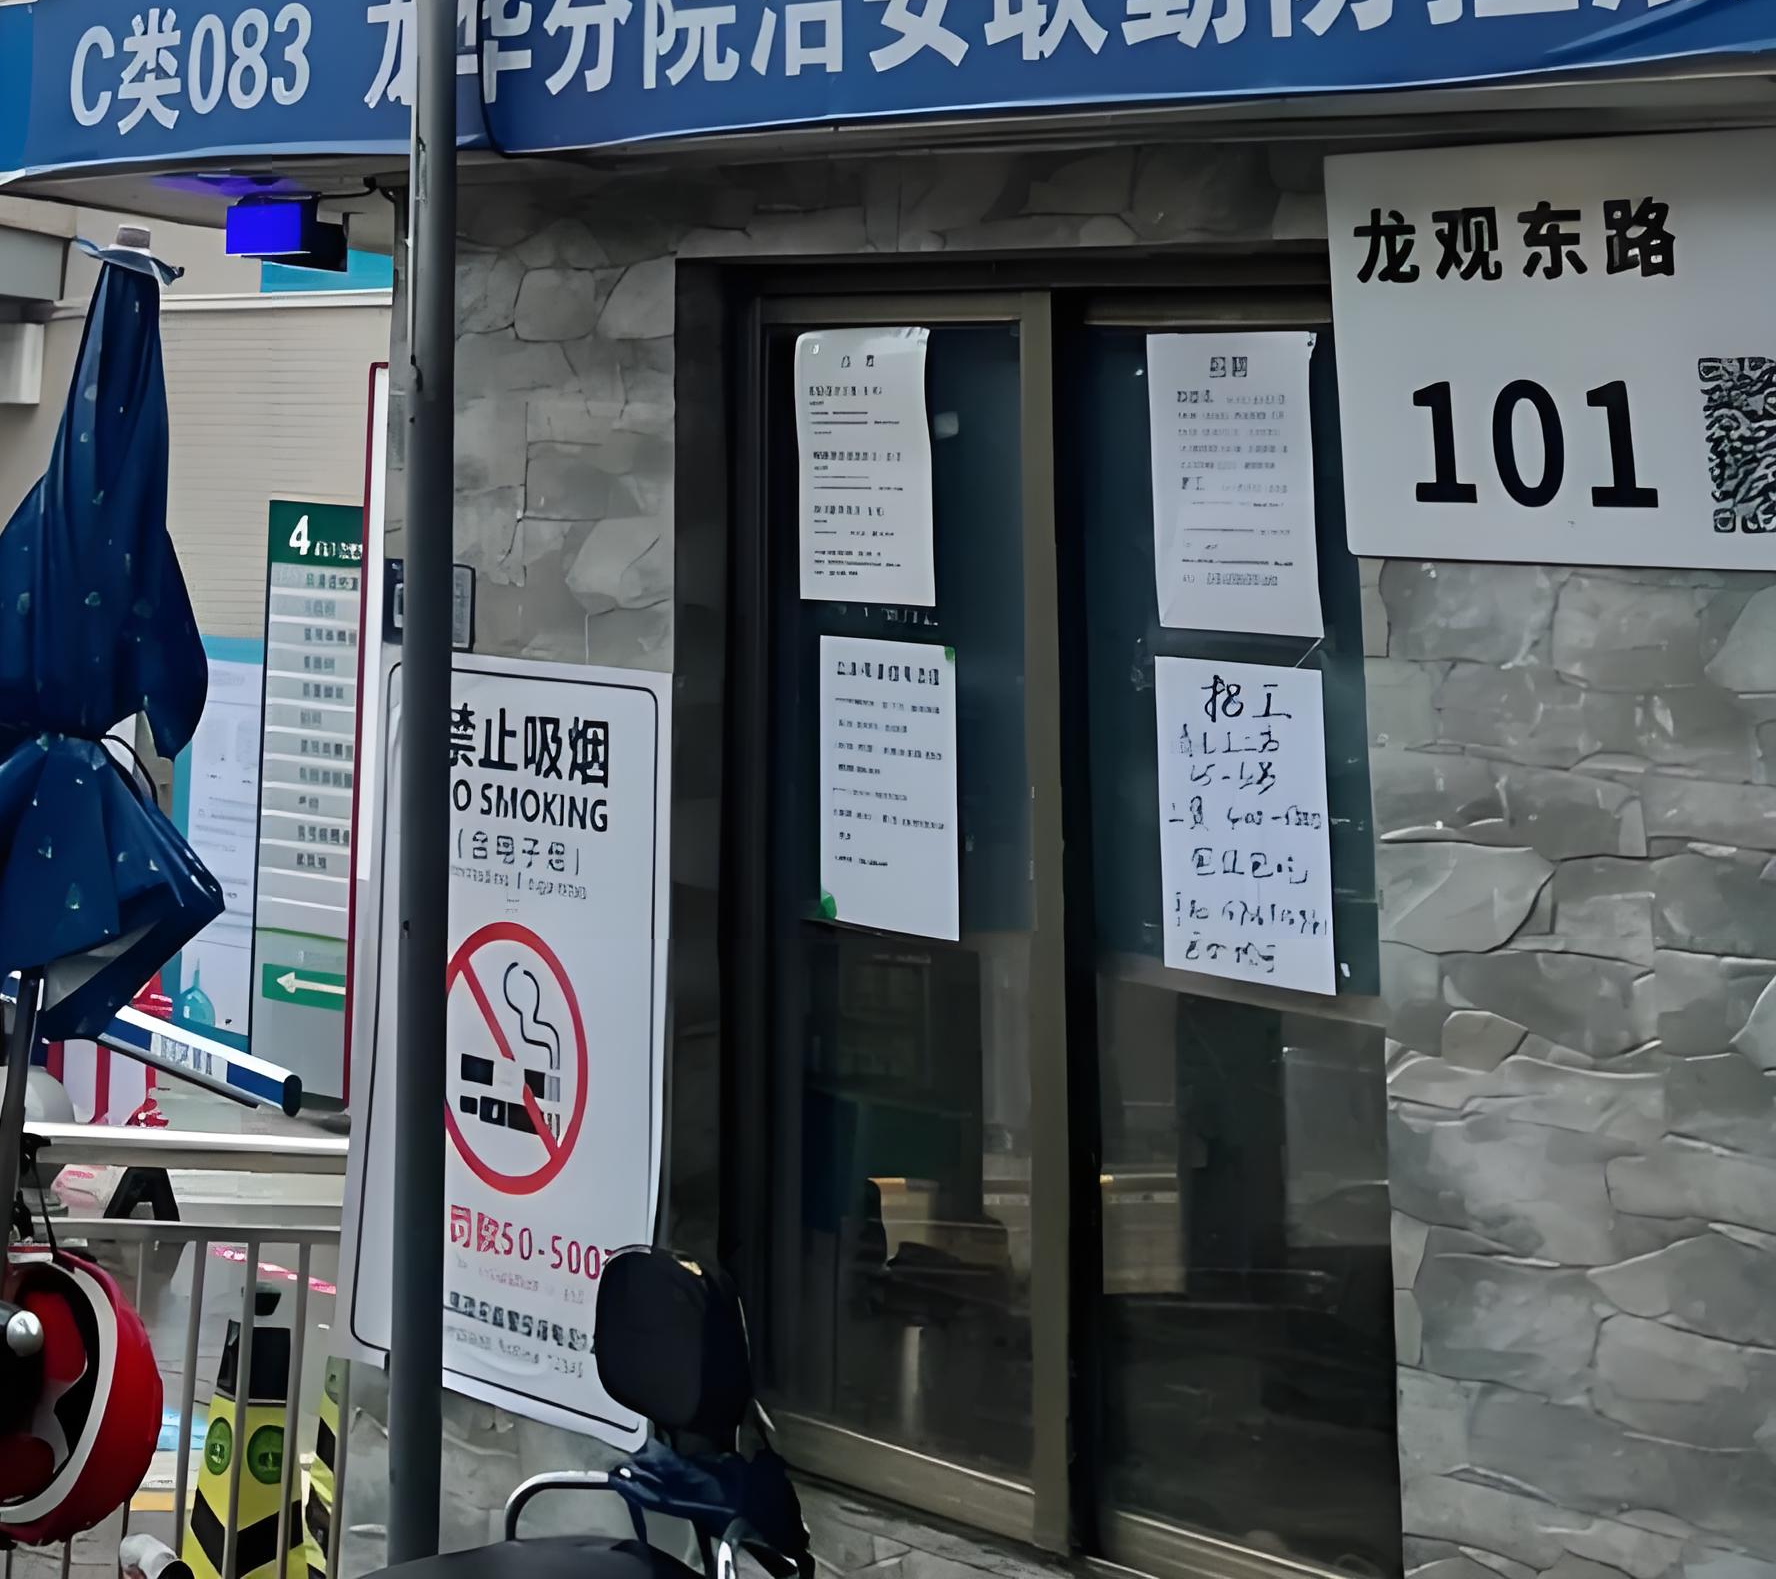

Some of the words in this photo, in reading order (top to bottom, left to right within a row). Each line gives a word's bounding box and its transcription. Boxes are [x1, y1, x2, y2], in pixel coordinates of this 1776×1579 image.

[70, 1, 314, 136] C类083
[1353, 197, 1678, 285] 龙观东路
[1411, 378, 1660, 509] 101
[288, 514, 311, 557] 4
[452, 779, 472, 812] O
[480, 782, 609, 834] SMOKING
